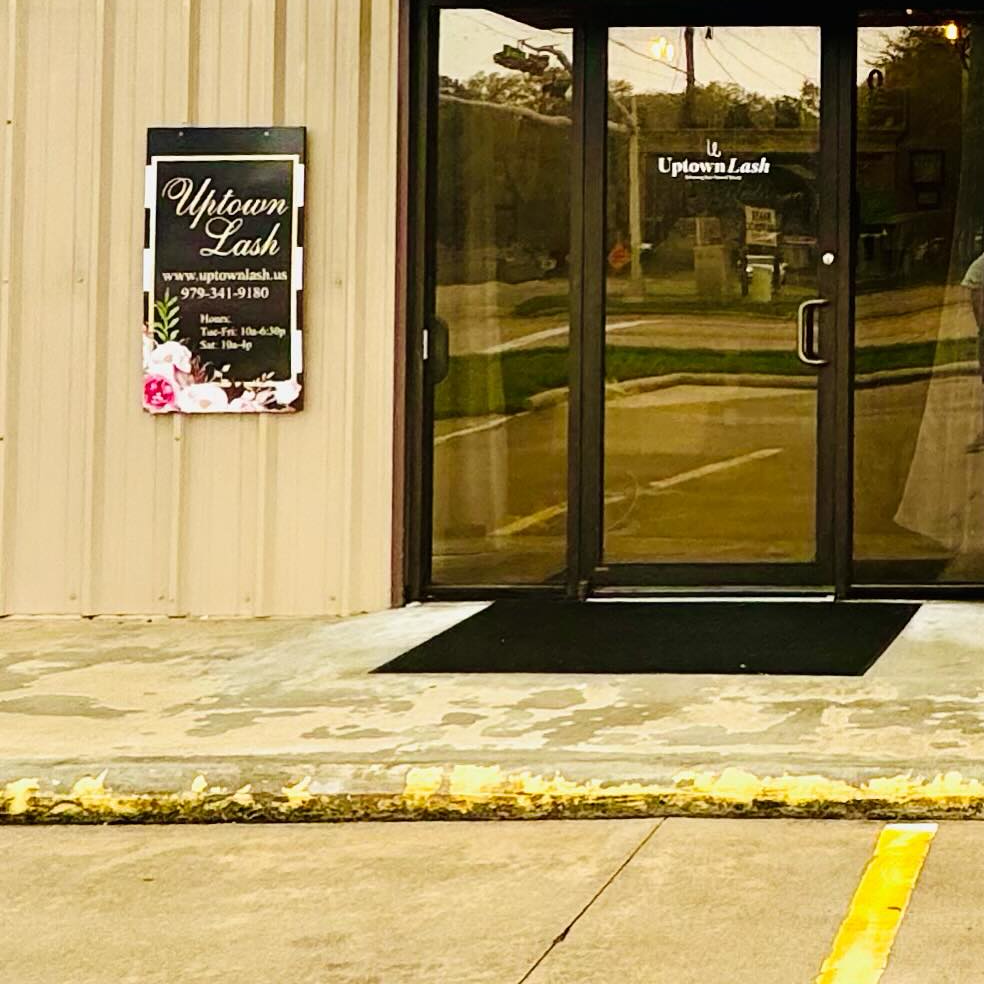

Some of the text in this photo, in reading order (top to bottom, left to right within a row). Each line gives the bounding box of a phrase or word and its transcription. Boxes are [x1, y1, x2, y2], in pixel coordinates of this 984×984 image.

[658, 157, 770, 177] Uptown Lash
[162, 177, 288, 229] Uptown
[200, 217, 280, 256] Lash
[162, 268, 288, 284] www.uptownlash.us
[181, 287, 269, 299] 979-341-9180
